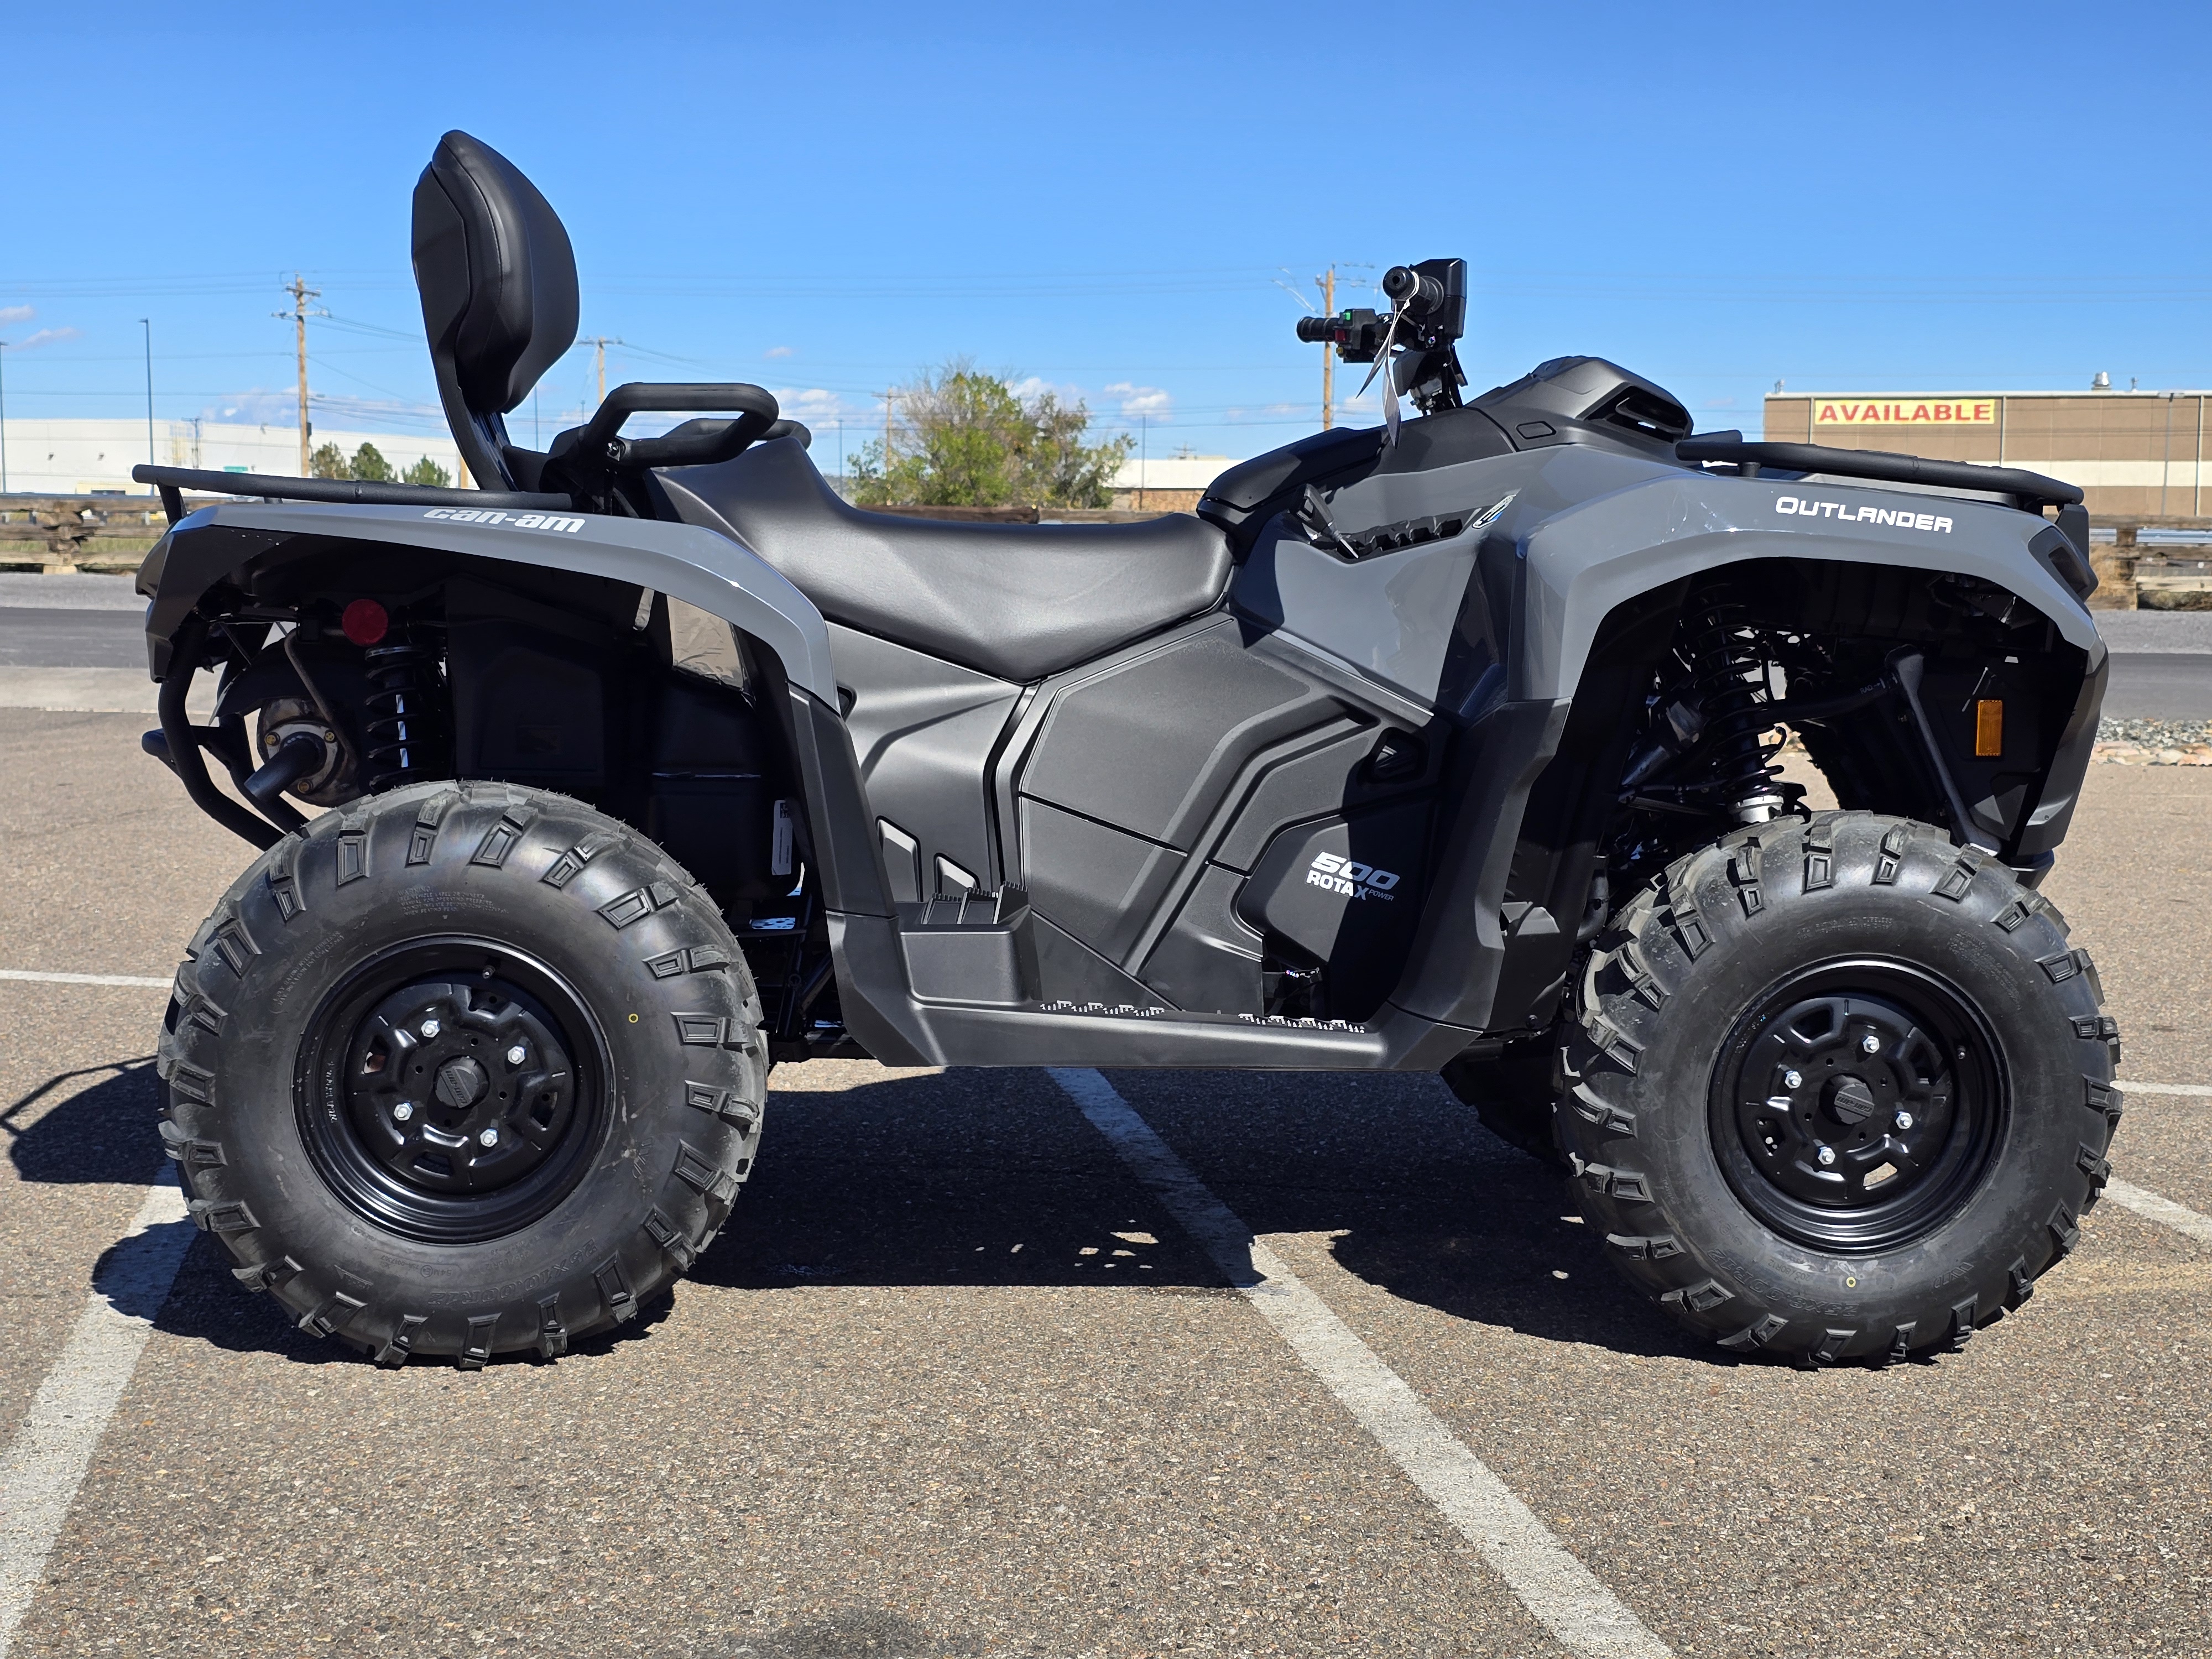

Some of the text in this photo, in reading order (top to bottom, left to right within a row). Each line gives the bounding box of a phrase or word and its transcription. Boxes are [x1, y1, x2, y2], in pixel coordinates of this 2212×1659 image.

[1819, 404, 1991, 421] AVAILABLE
[423, 508, 586, 533] can-am
[1775, 497, 1953, 533] OUTLANDER
[1306, 869, 1394, 902] ROTAX POWER
[1311, 852, 1400, 890] 500
[1837, 1097, 1872, 1113] can-am
